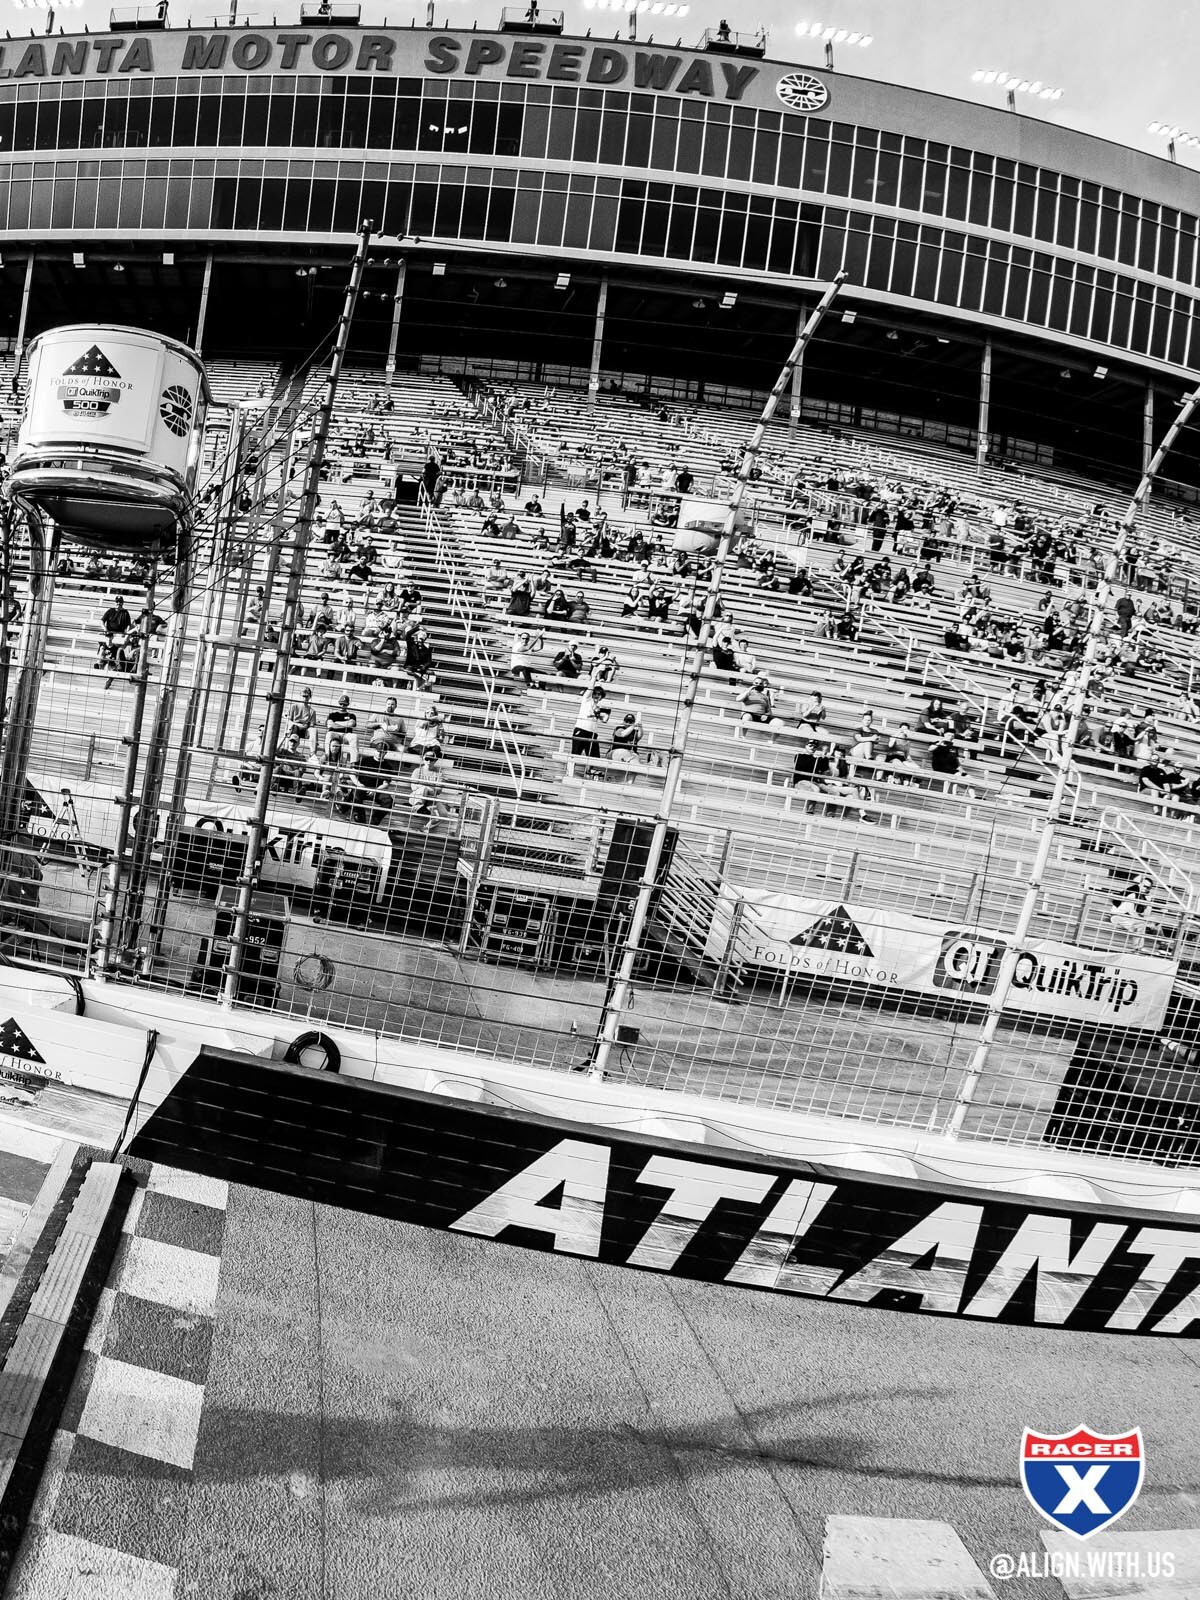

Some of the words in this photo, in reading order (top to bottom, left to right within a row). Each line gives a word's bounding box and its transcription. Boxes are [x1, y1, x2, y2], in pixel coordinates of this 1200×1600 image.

[181, 33, 398, 71] MOTOR
[424, 36, 760, 101] SPEEDWAY
[50, 377, 79, 386] FOLDS
[81, 376, 90, 386] of
[93, 376, 134, 391] HONOR
[79, 387, 110, 399] QuikTrip
[72, 400, 99, 410] 500
[754, 945, 811, 969] FOLDS
[816, 957, 832, 975] of
[835, 959, 898, 984] HONOR
[944, 939, 996, 986] QT
[1011, 951, 1139, 1013] QuikTrip
[11, 1057, 62, 1080] HONOR
[449, 1139, 1200, 1333] ATLANT
